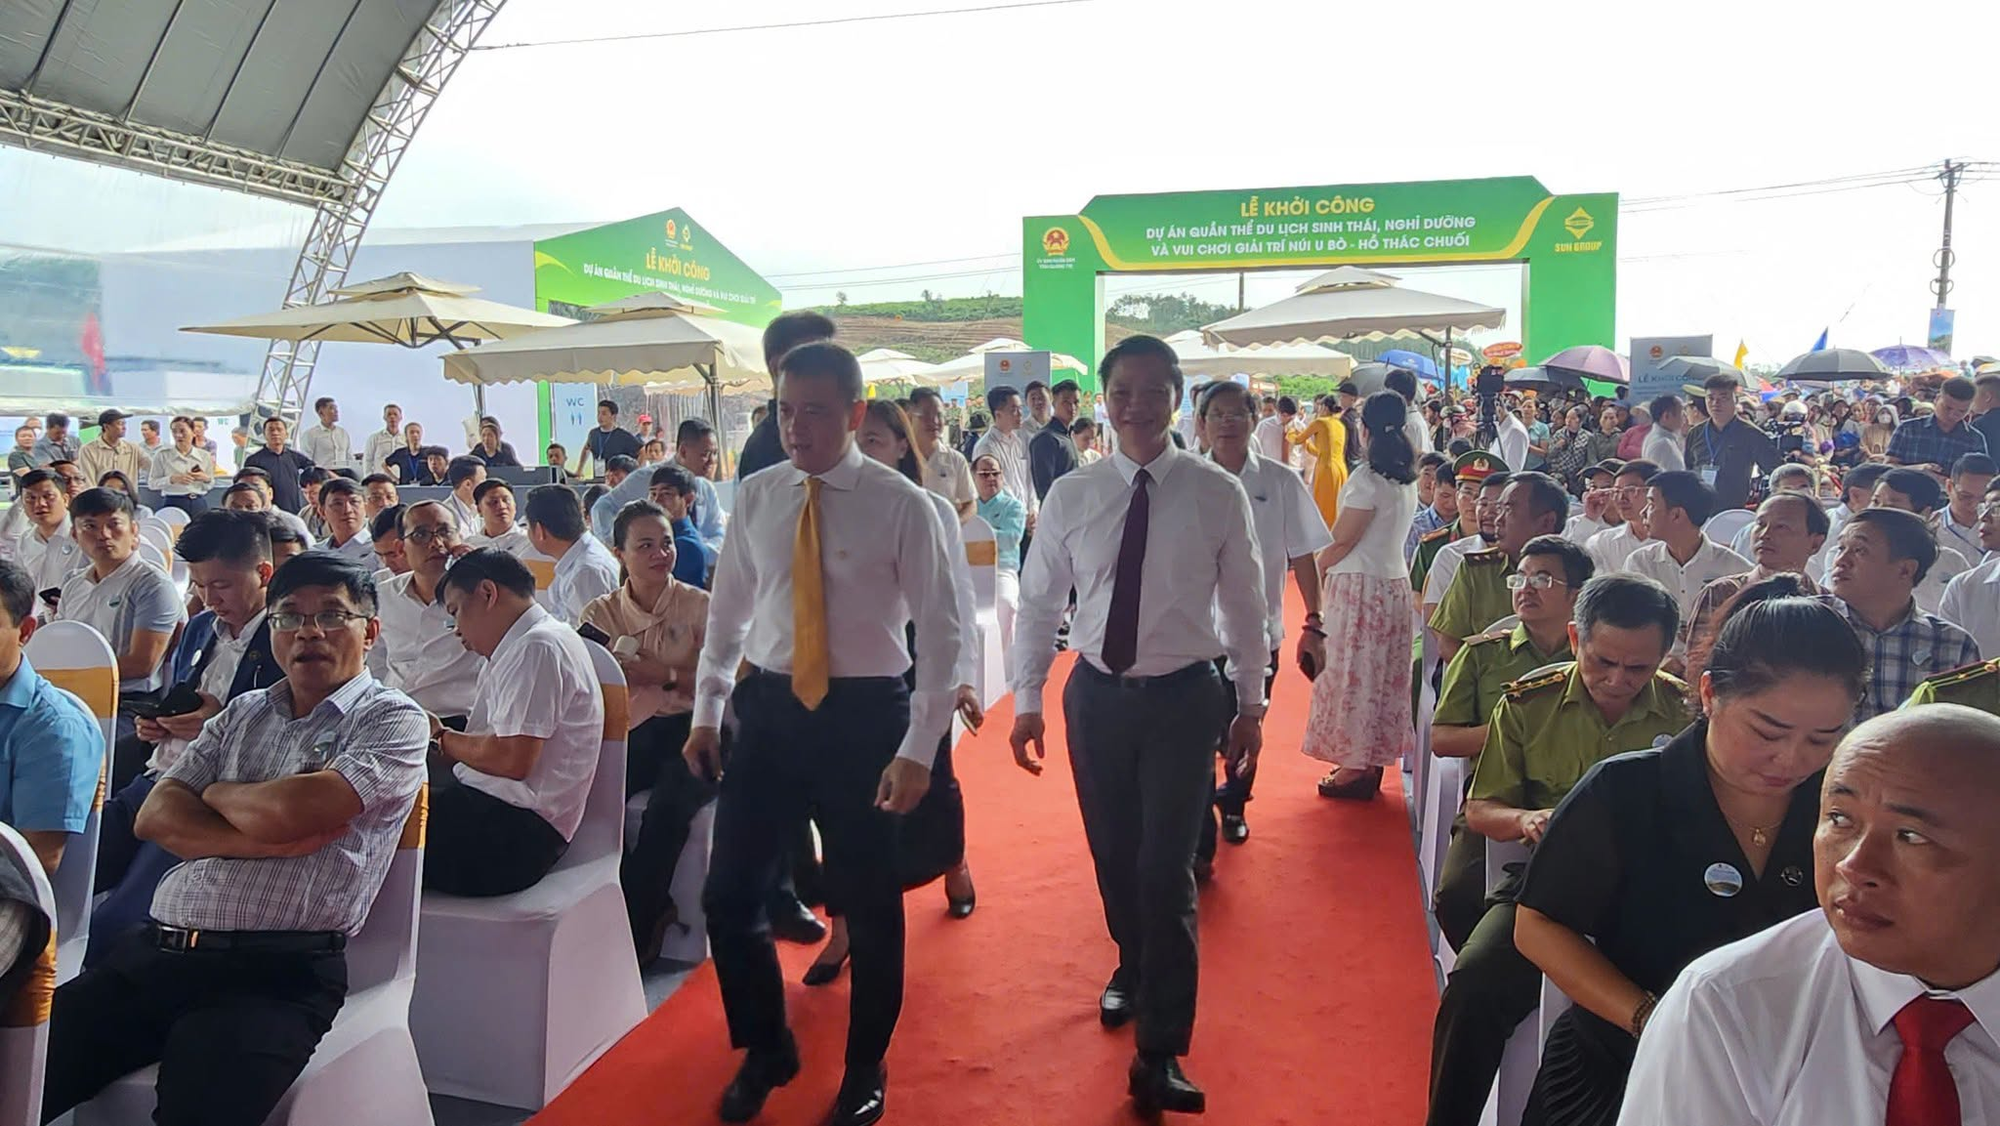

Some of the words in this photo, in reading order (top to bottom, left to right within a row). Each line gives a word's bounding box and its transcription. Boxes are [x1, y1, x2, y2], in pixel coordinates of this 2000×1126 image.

[1240, 195, 1259, 217] LỄ
[1264, 195, 1310, 216] KHỞI
[1315, 195, 1376, 214] CÔNG
[1146, 226, 1164, 241] DỰ
[1167, 224, 1186, 239] ÁN
[1189, 221, 1227, 238] QUẦN
[1230, 219, 1253, 236] THỂ
[1256, 223, 1274, 235] DU
[1278, 222, 1309, 237] LỊCH
[1311, 221, 1343, 233] SINH
[1346, 218, 1381, 233] THÁI,
[1384, 215, 1420, 231] NGHỈ
[1423, 215, 1476, 230] DƯỠNG
[1151, 242, 1169, 256] VÀ
[1172, 244, 1194, 256] VUI
[1197, 242, 1231, 255] CHƠI
[1234, 239, 1263, 254] GIẢI
[1266, 239, 1285, 253] TRÍ
[1288, 238, 1311, 252] NÚI
[1314, 240, 1324, 251] U
[1327, 237, 1347, 251] BÒ
[1358, 234, 1379, 250] HỒ
[1383, 235, 1421, 249] THÁC
[1423, 231, 1470, 248] CHUỐI
[646, 246, 657, 270] LỄ
[566, 397, 585, 407] WC
